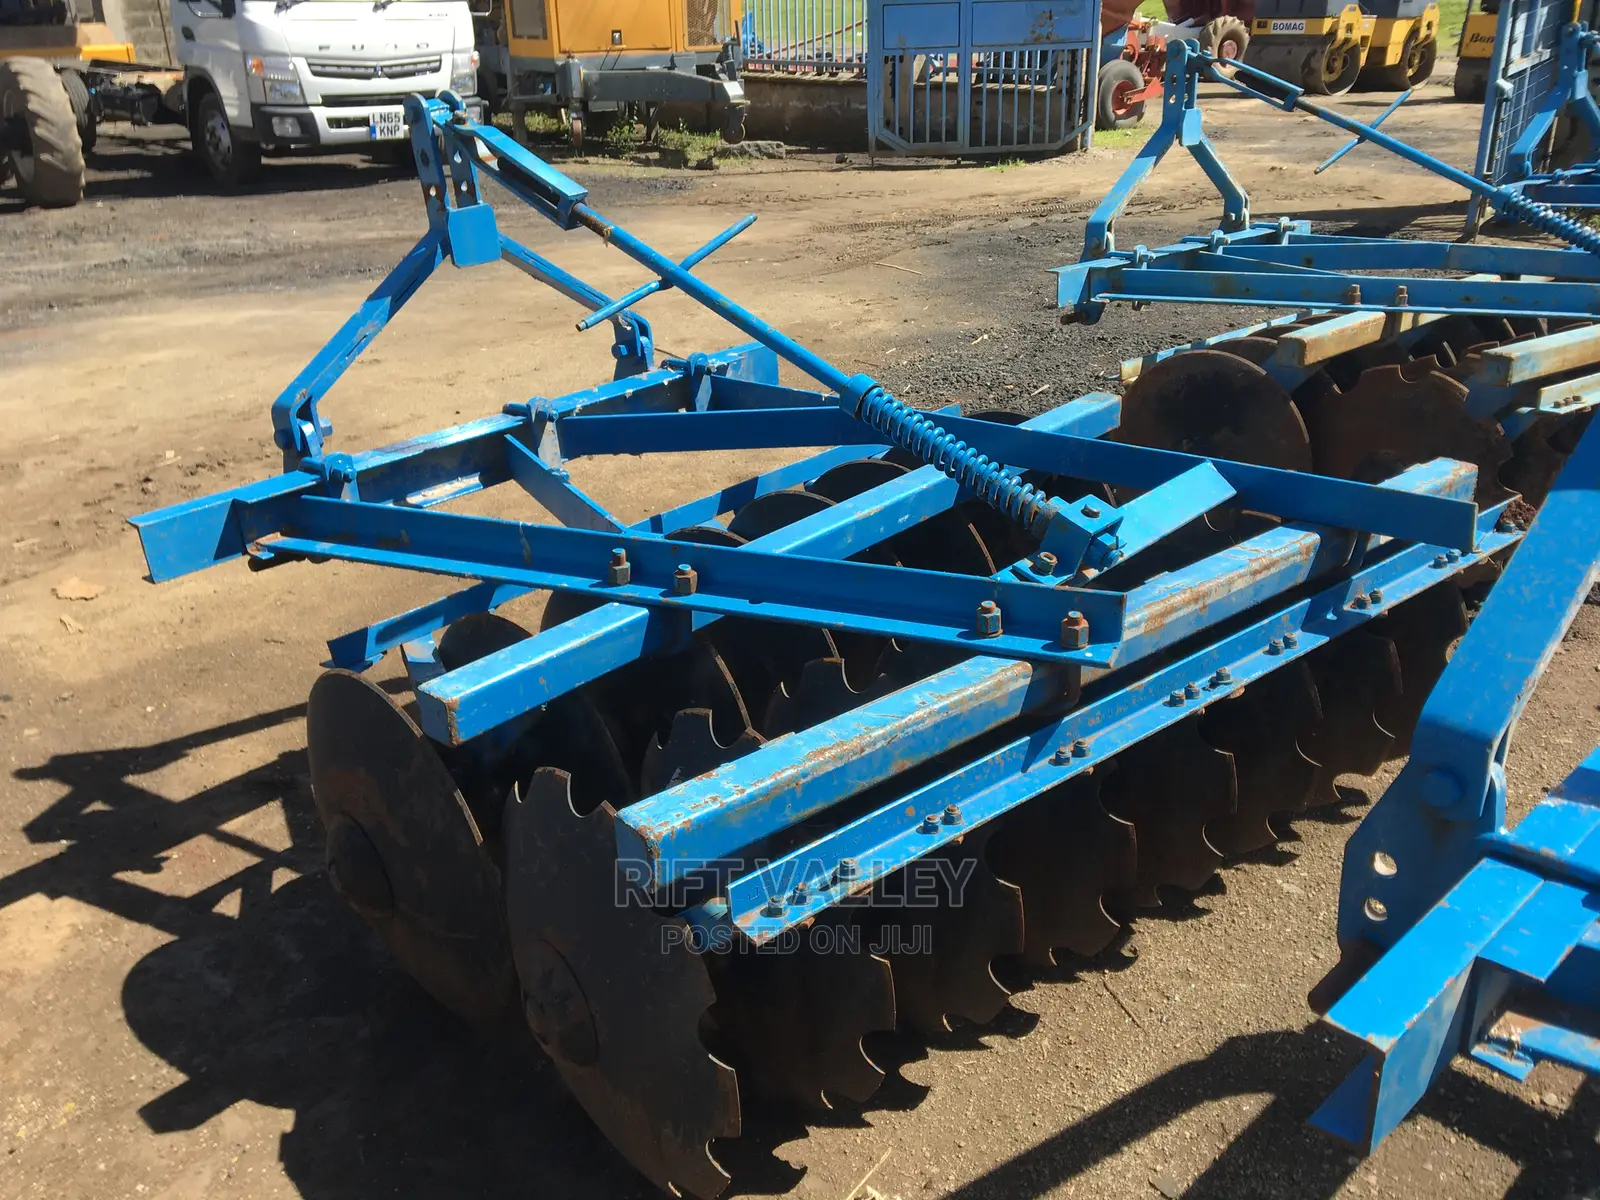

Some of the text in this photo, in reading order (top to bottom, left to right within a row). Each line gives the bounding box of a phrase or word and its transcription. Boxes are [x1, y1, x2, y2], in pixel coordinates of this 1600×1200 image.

[1272, 22, 1305, 31] BOMAG
[372, 112, 401, 124] LN65
[379, 124, 400, 137] KNP
